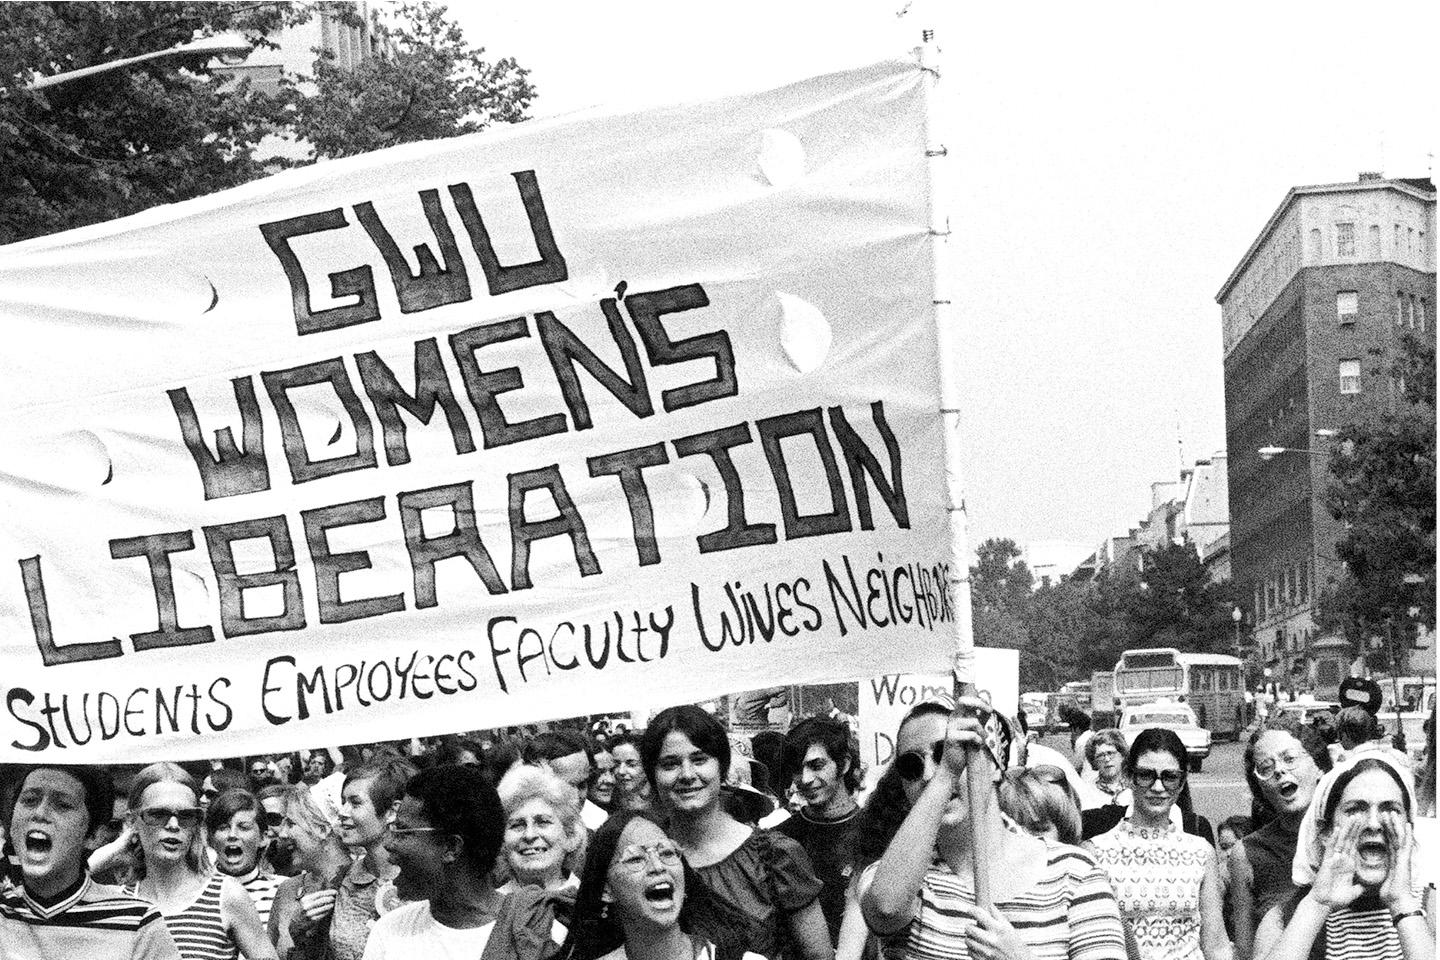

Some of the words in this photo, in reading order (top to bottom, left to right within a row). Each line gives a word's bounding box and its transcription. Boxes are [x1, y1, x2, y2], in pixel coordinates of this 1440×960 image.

[260, 169, 568, 335] GWU
[167, 280, 738, 499] WOMEN'S
[18, 401, 911, 667] LIBERATION
